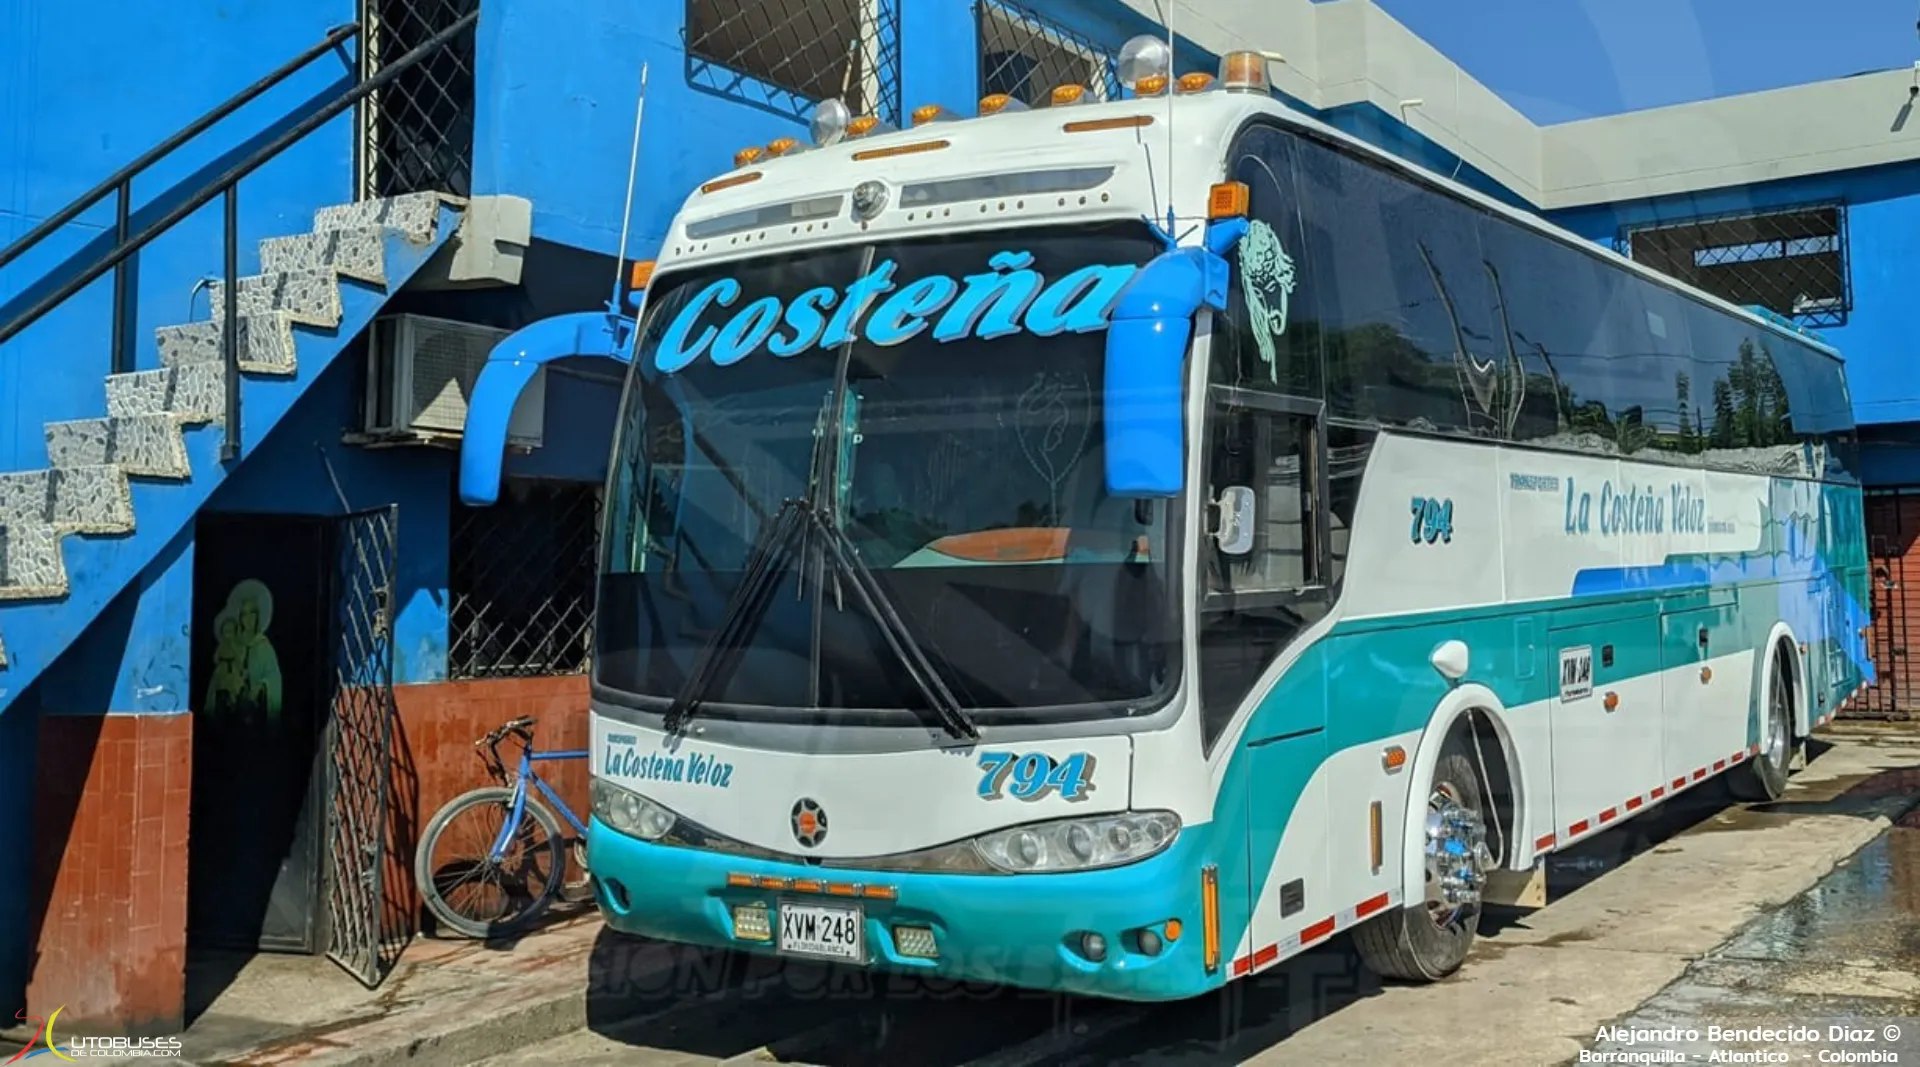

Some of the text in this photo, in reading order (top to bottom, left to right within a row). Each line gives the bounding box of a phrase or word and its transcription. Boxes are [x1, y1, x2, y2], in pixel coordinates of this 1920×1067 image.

[654, 250, 1139, 374] Costeña
[1411, 496, 1454, 545] 794
[1564, 477, 1706, 537] La Costeña Veloz
[605, 744, 622, 777] La
[687, 751, 735, 789] Veloz
[976, 750, 1097, 804] 794
[783, 912, 856, 945] XVM 248
